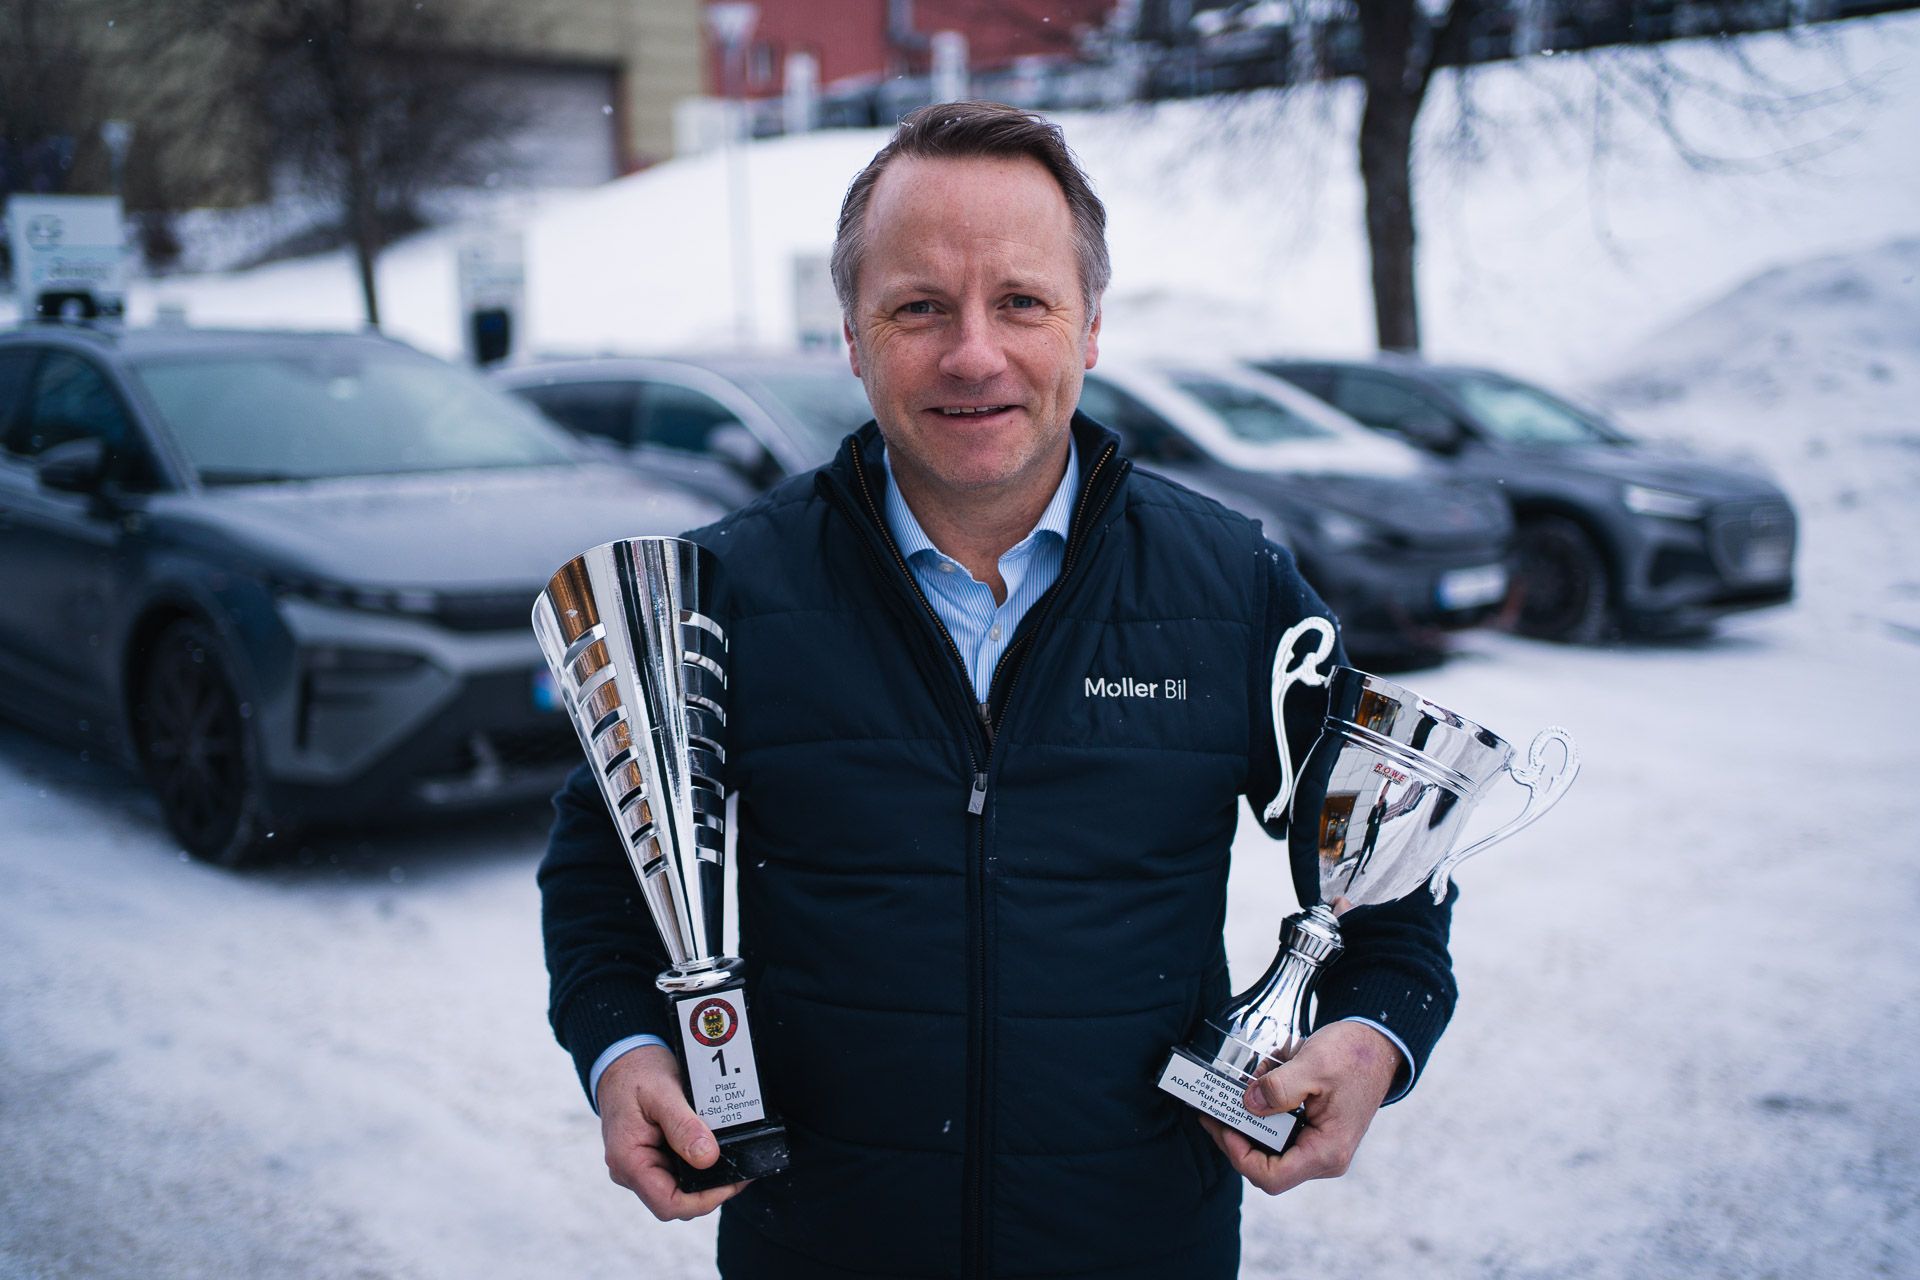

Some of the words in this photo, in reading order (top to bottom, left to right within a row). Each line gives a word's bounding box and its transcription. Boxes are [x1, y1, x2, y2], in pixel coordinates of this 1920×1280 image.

[1165, 678, 1187, 700] Bil
[1375, 762, 1408, 782] ROWE
[711, 1048, 741, 1077] 1.
[715, 1082, 737, 1092] Platz
[1195, 1079, 1215, 1093] ROWE
[1218, 1091, 1229, 1101] 6h
[1203, 1071, 1245, 1099] Klassensi
[709, 1095, 723, 1104] 40.
[725, 1089, 746, 1101] DMV
[1170, 1075, 1278, 1137] ADAC-Ruhr-Pokal-Rennen
[699, 1098, 760, 1117] 4-Std.-Rennen
[720, 1111, 742, 1124] 2015
[1208, 1105, 1228, 1120] August
[1227, 1115, 1242, 1126] 2017
